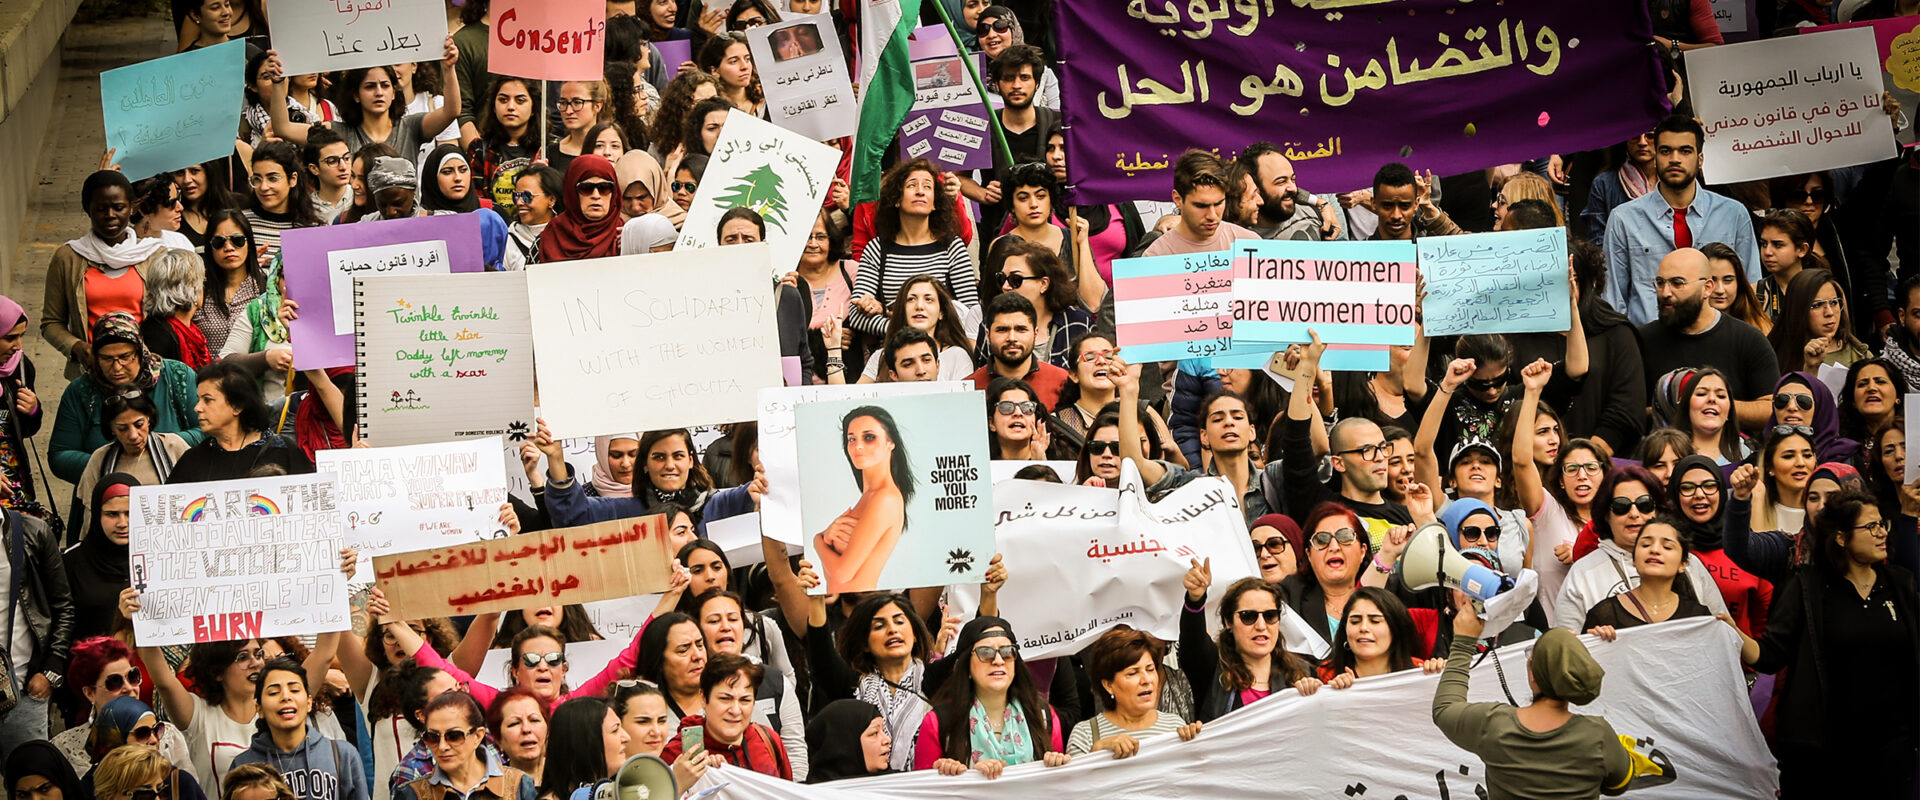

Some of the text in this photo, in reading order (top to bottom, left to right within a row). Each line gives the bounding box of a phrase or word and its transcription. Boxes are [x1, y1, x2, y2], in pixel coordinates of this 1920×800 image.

[376, 25, 422, 52] بعاد
[497, 7, 605, 54] Consent?
[776, 72, 800, 85] لموت
[1097, 17, 1561, 120] والتضامن هو الحل
[1849, 61, 1863, 81] يا
[1718, 69, 1799, 98] الجمهورية
[943, 87, 972, 102] كسري
[1863, 93, 1881, 109] لنا
[1753, 106, 1797, 128] قانون
[1801, 102, 1831, 124] في
[1835, 99, 1859, 117] حق
[1731, 121, 1863, 155] للاحوال الشخصية
[339, 259, 373, 275] حماية
[376, 253, 408, 273] قانون
[1184, 254, 1230, 274] مغايرة
[1243, 247, 1401, 283] Trans women
[1184, 277, 1232, 295] متغيرة
[1524, 273, 1556, 291] على
[386, 304, 500, 324] Twinkle twinkle
[561, 288, 604, 337] IN
[1232, 297, 1414, 326] are women too
[419, 327, 484, 342] little star
[1184, 320, 1209, 334] ضد
[395, 347, 509, 367] Daddy left mommy
[648, 342, 689, 362] THE
[696, 335, 764, 356] WOMEN
[409, 367, 488, 379] with a scar
[605, 391, 632, 409] OF
[342, 460, 376, 483] AM
[378, 458, 395, 481] A
[401, 451, 478, 478] WOMAN
[935, 454, 971, 470] WHAT
[403, 475, 445, 494] YOUR
[930, 467, 978, 484] SHOCKS
[943, 482, 967, 497] YOU
[139, 480, 335, 526] WE ARE THE
[935, 495, 978, 511] MORE?
[1042, 505, 1078, 521] كل
[1080, 509, 1118, 521] من
[158, 551, 197, 581] THE
[201, 543, 303, 578] WITCHES
[375, 521, 648, 585] السبب الوحيد للاغتصاب
[296, 574, 335, 606] TO
[448, 572, 580, 613] هو المغتصب
[193, 610, 264, 643] BURN
[1023, 631, 1062, 649] لمتابعة
